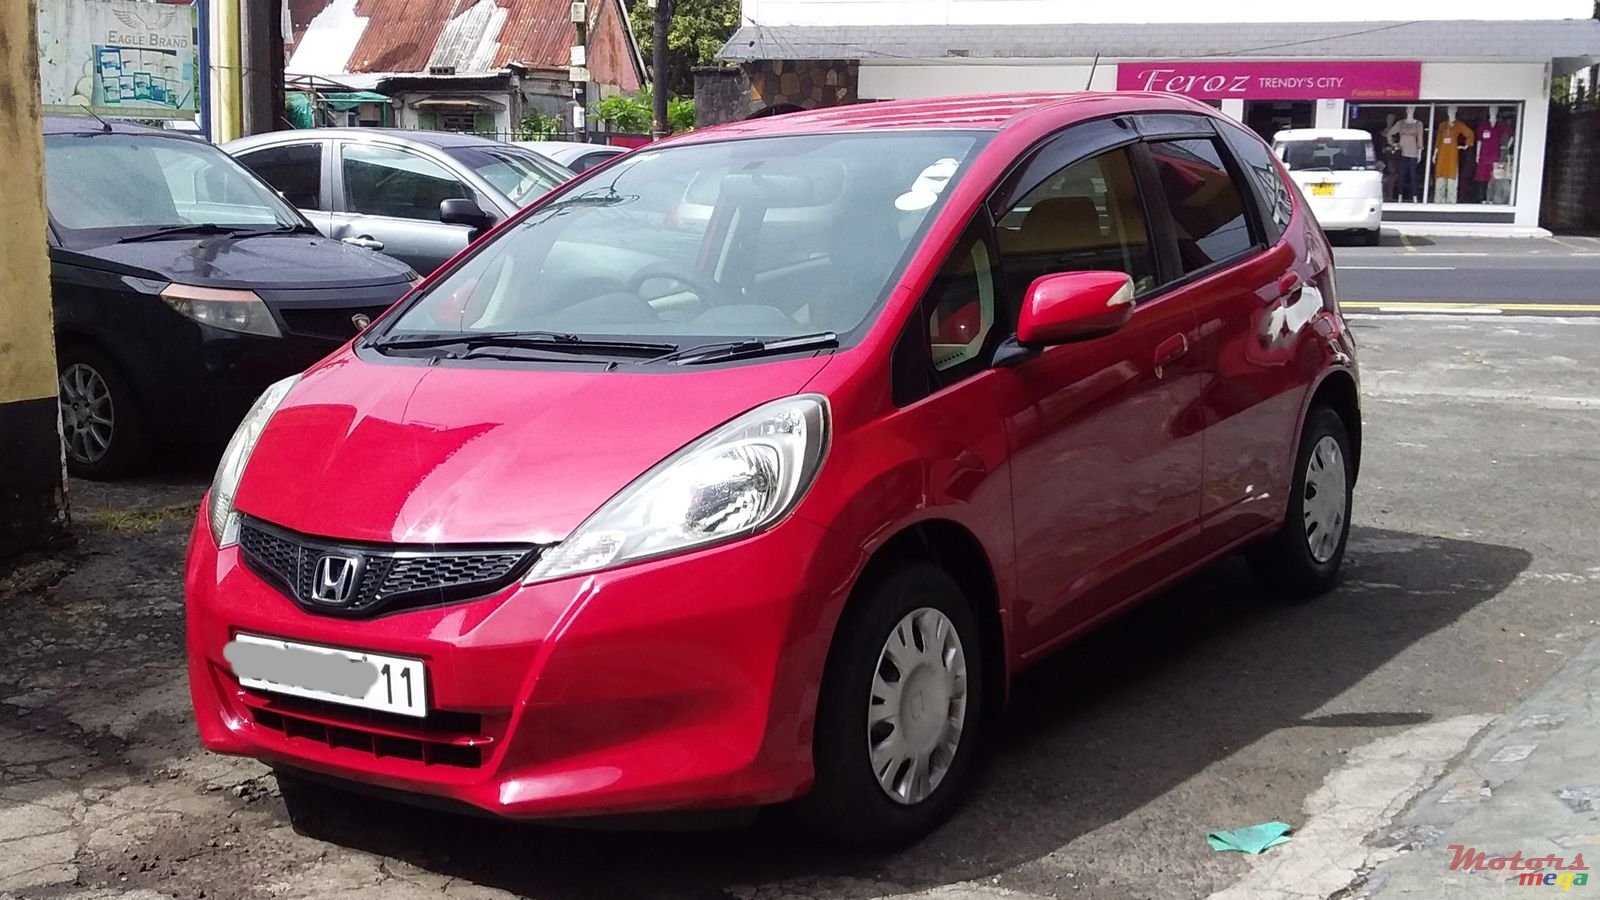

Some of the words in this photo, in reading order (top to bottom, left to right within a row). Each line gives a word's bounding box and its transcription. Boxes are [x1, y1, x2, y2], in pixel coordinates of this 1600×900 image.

[108, 30, 145, 45] EAGLE
[149, 33, 188, 49] BRAND
[1137, 69, 1251, 92] Feroz
[1259, 77, 1314, 88] TRENDY'S
[1317, 77, 1344, 88] CITY
[381, 664, 413, 708] 11
